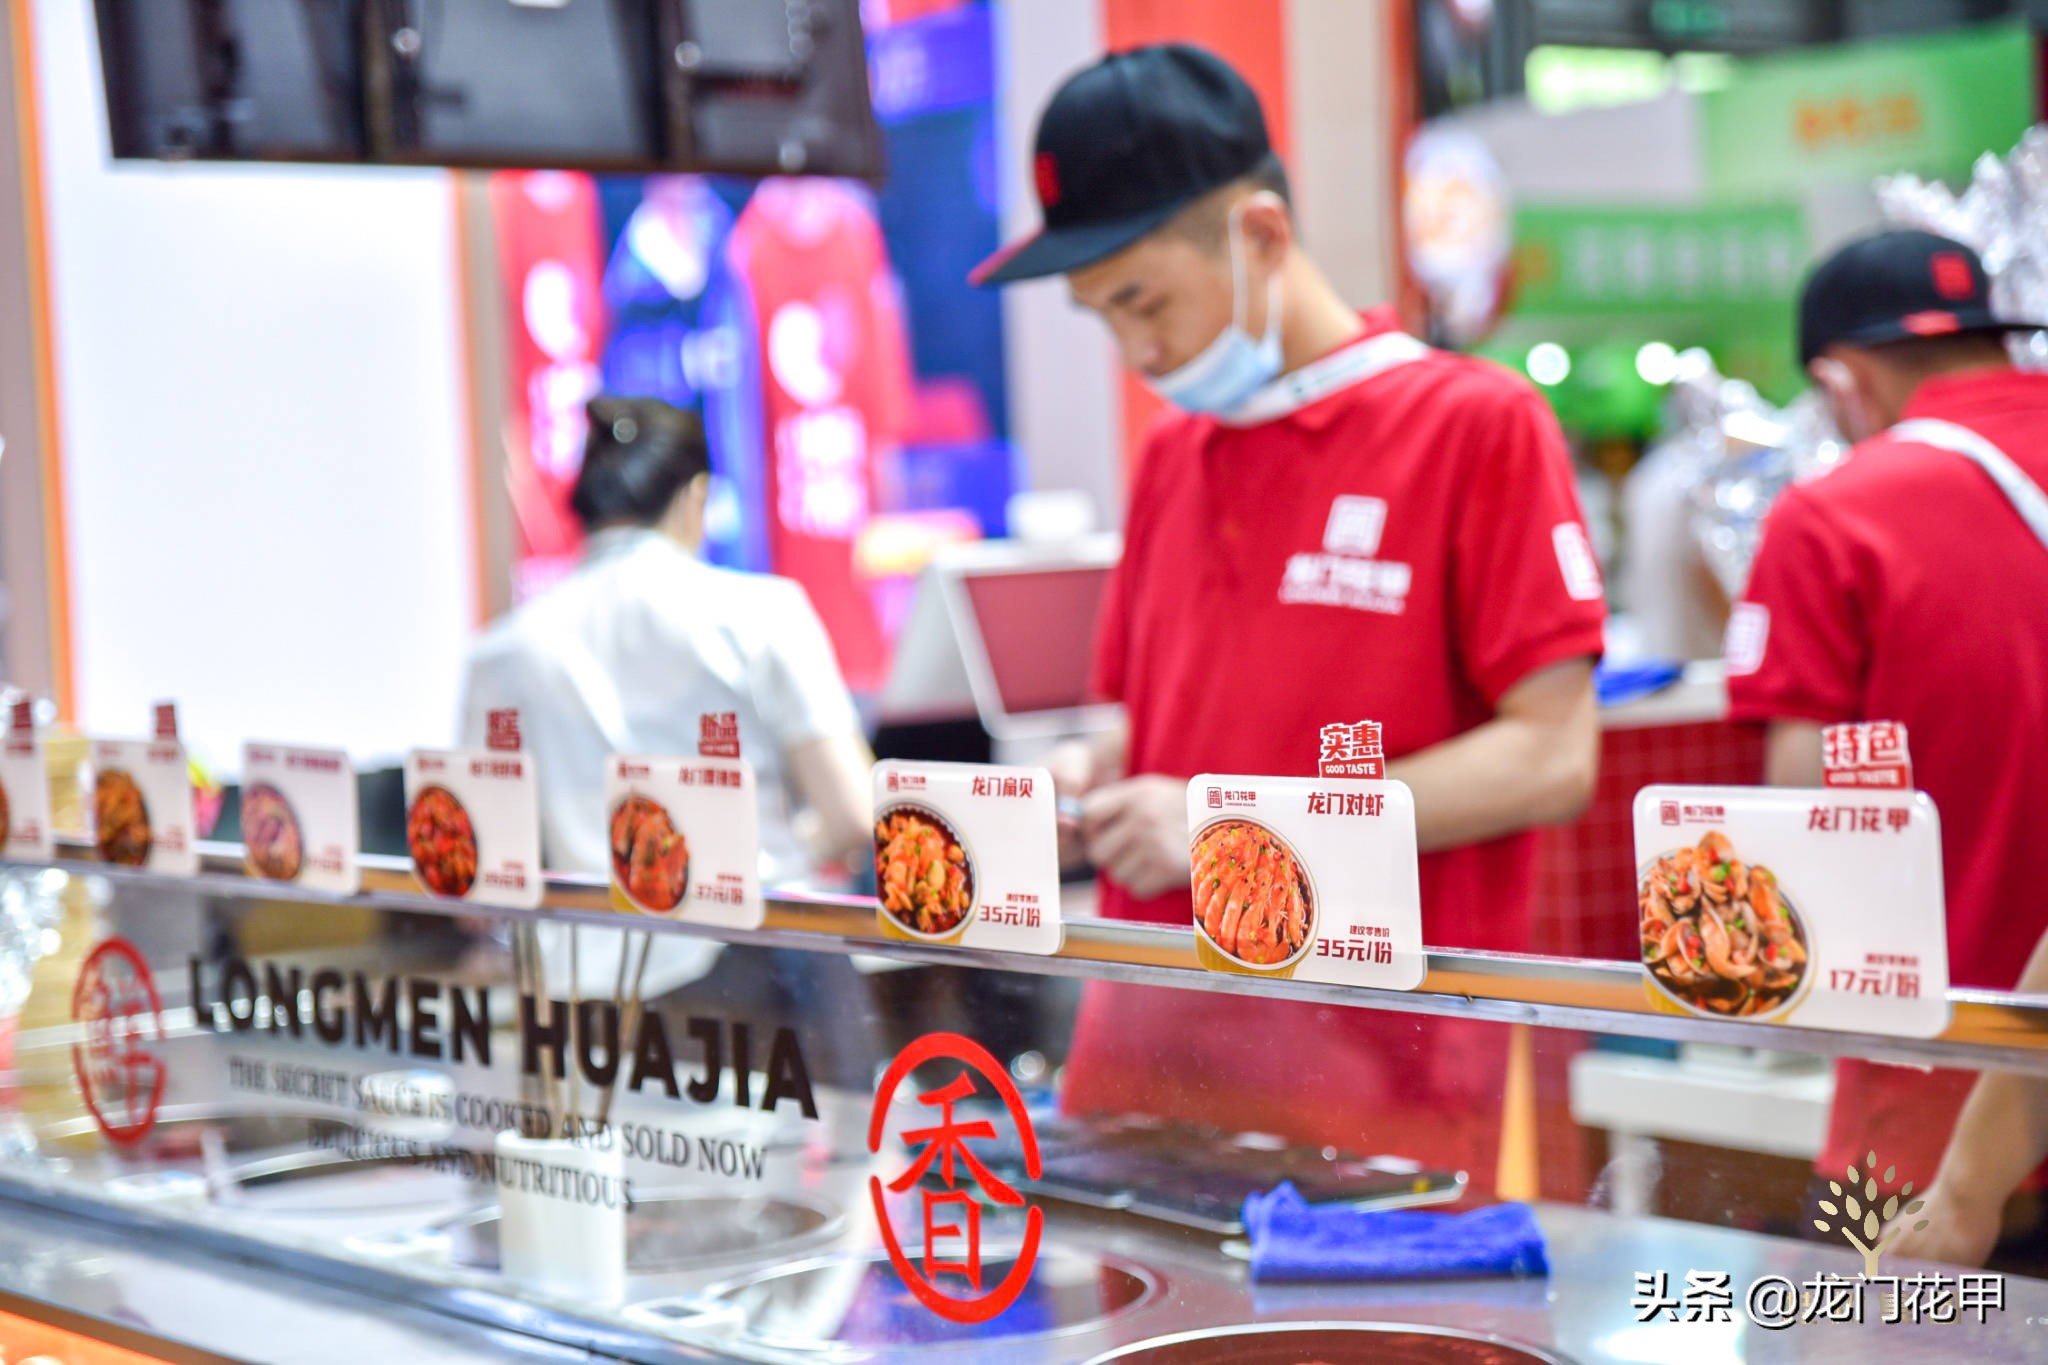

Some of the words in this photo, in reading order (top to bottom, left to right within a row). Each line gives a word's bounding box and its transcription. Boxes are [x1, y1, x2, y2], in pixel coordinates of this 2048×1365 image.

[1322, 723, 1381, 759] 实惠
[1823, 723, 1905, 766] 特色
[1325, 764, 1345, 775] GOOD
[1346, 763, 1376, 775] TASTE
[972, 776, 1033, 798] 龙门扇贝
[1224, 790, 1256, 801] 龙门花甲
[1307, 792, 1384, 817] 龙门对虾
[1807, 806, 1909, 833] 龙门花甲
[980, 905, 1040, 928] 35元/份
[1316, 938, 1392, 964] 35元/份
[1830, 969, 1920, 999] 17元/份
[189, 955, 492, 1066] LONGMEN
[521, 995, 819, 1121] HUAJIA
[229, 1055, 265, 1091] THE
[272, 1061, 350, 1102] SECRET
[454, 1091, 550, 1139] COOKED
[562, 1111, 613, 1152] AND
[623, 1121, 691, 1168] SOLD
[698, 1136, 768, 1181] NOW
[477, 1151, 634, 1214] NUTRITIOUS
[887, 1070, 1026, 1292] 香
